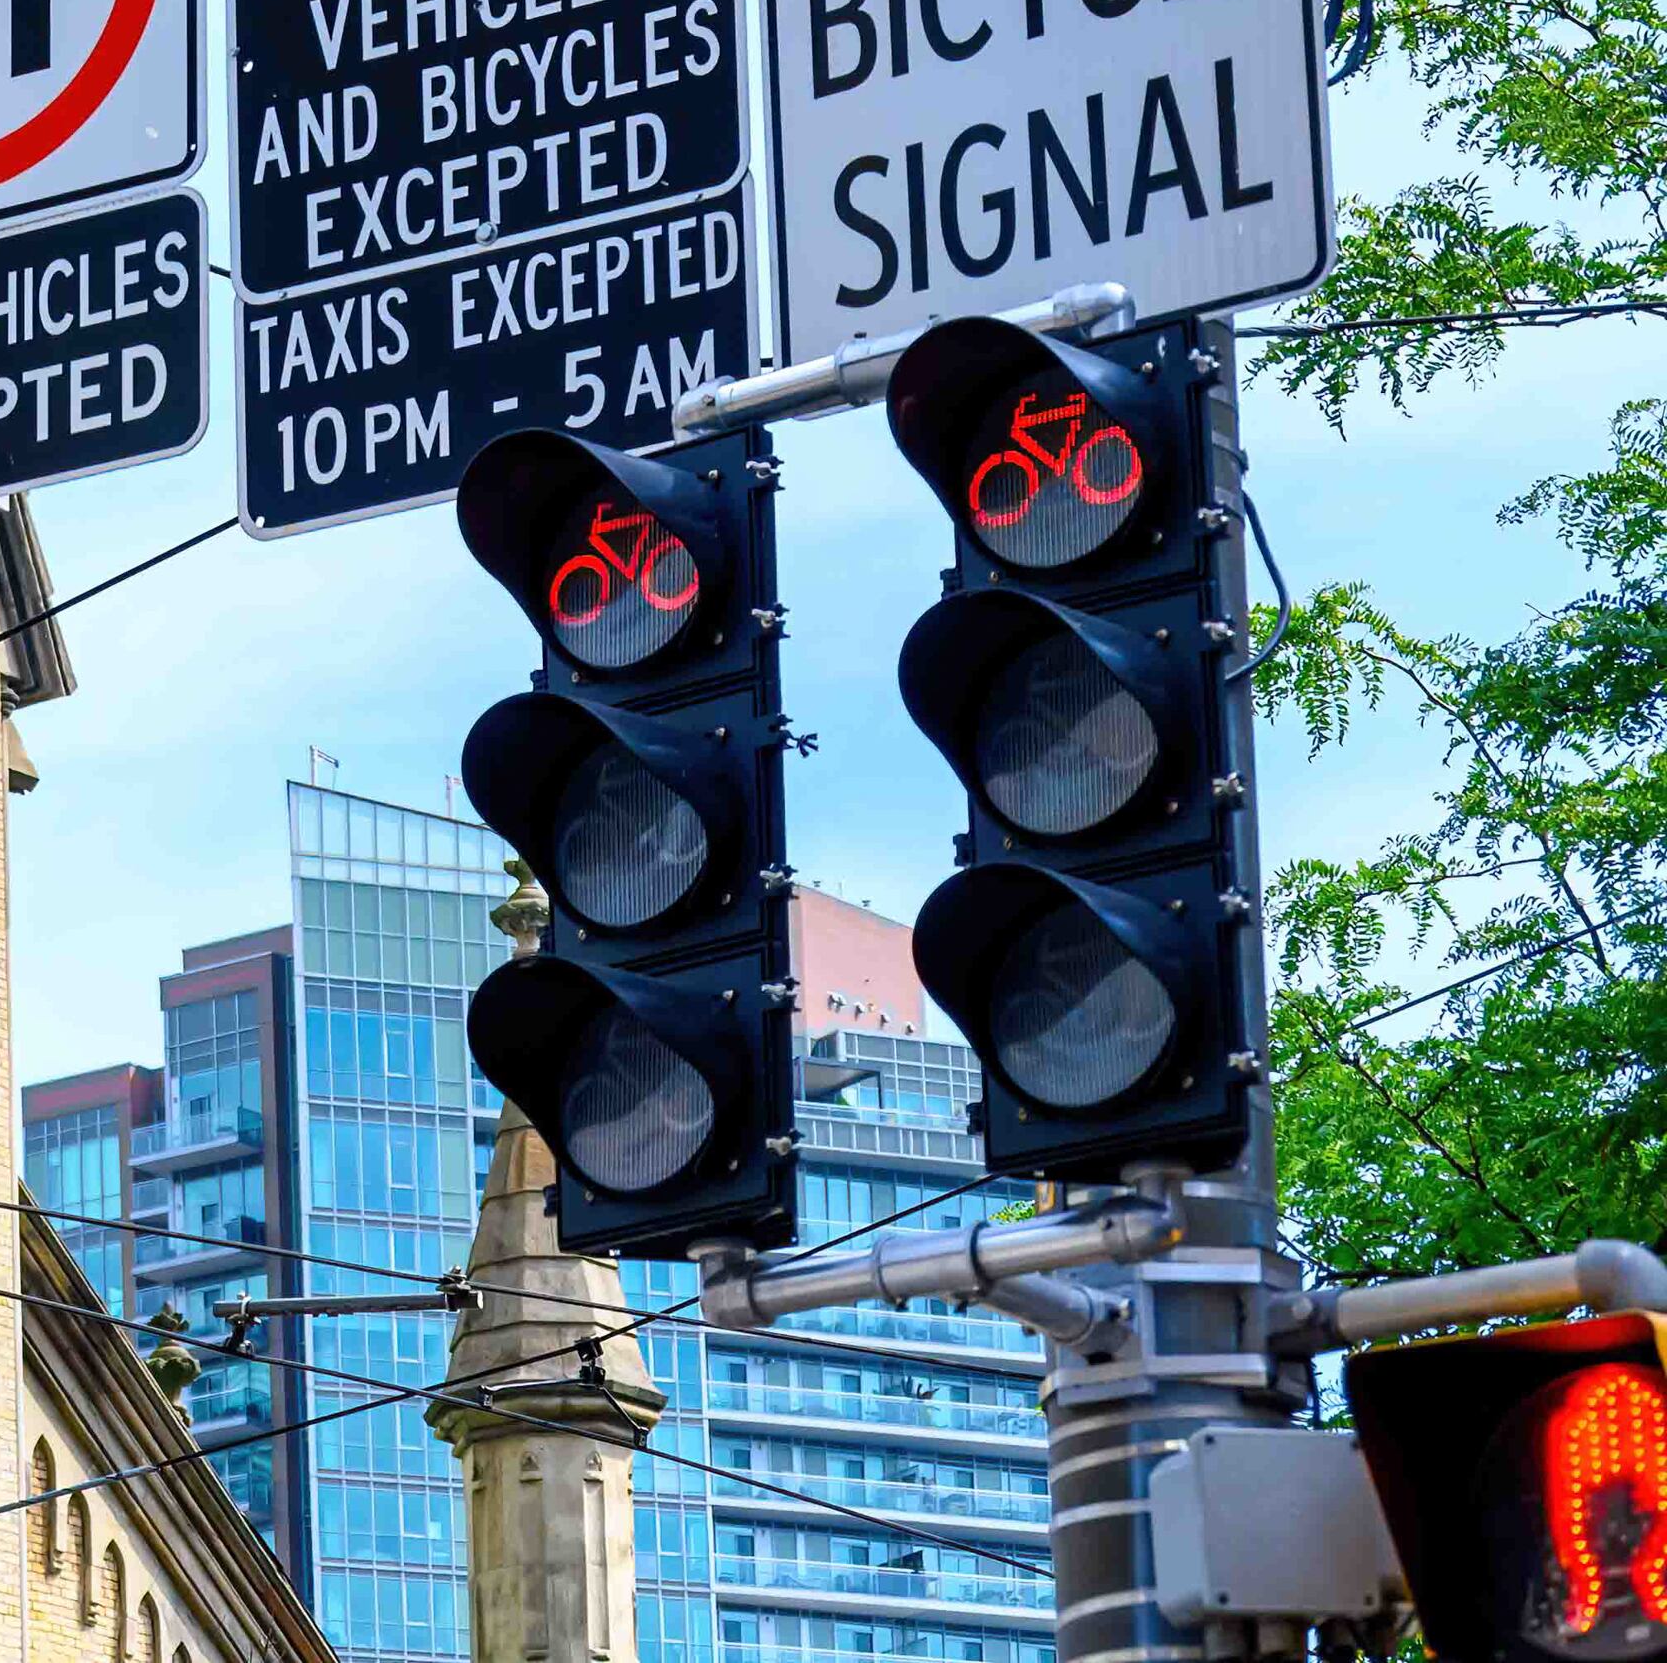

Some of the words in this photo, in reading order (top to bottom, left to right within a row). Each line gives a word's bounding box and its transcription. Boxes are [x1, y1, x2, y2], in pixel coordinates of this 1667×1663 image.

[253, 84, 379, 185] AND
[306, 112, 668, 271] EXCEPTED
[833, 57, 1274, 308] SIGNAL
[250, 286, 410, 394] TAXIS
[452, 209, 740, 350] EXCEPTED
